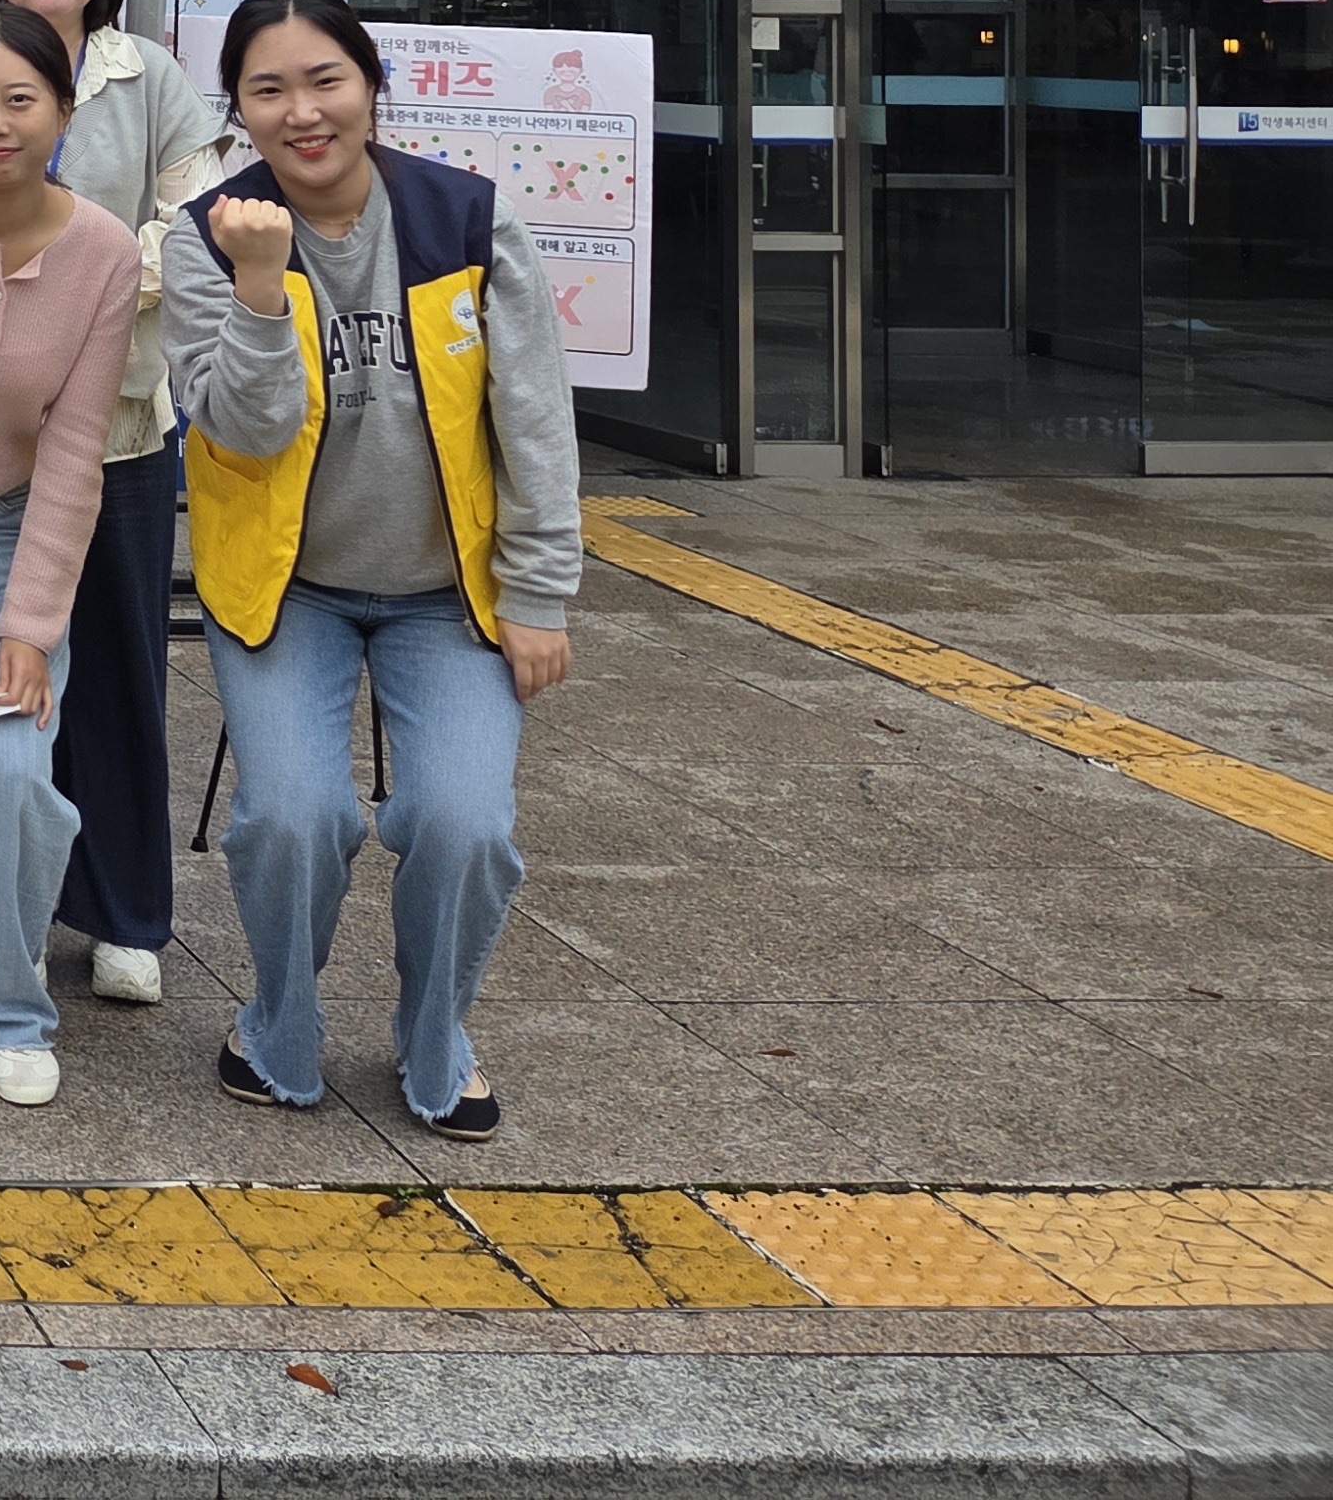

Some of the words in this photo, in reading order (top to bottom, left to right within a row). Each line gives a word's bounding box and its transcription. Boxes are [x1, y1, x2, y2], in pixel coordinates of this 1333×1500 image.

[413, 38, 471, 56] 함께하는
[407, 59, 495, 97] 퀴즈
[422, 110, 458, 126] 걸리는
[460, 112, 483, 127] 것은
[486, 113, 522, 128] 본인이
[524, 116, 572, 132] 나약하기
[575, 117, 626, 133] 때문이다.
[1240, 112, 1259, 131] 15
[1261, 114, 1328, 131] 학생복지센터
[563, 240, 588, 255] 알고
[591, 241, 620, 257] 있다.
